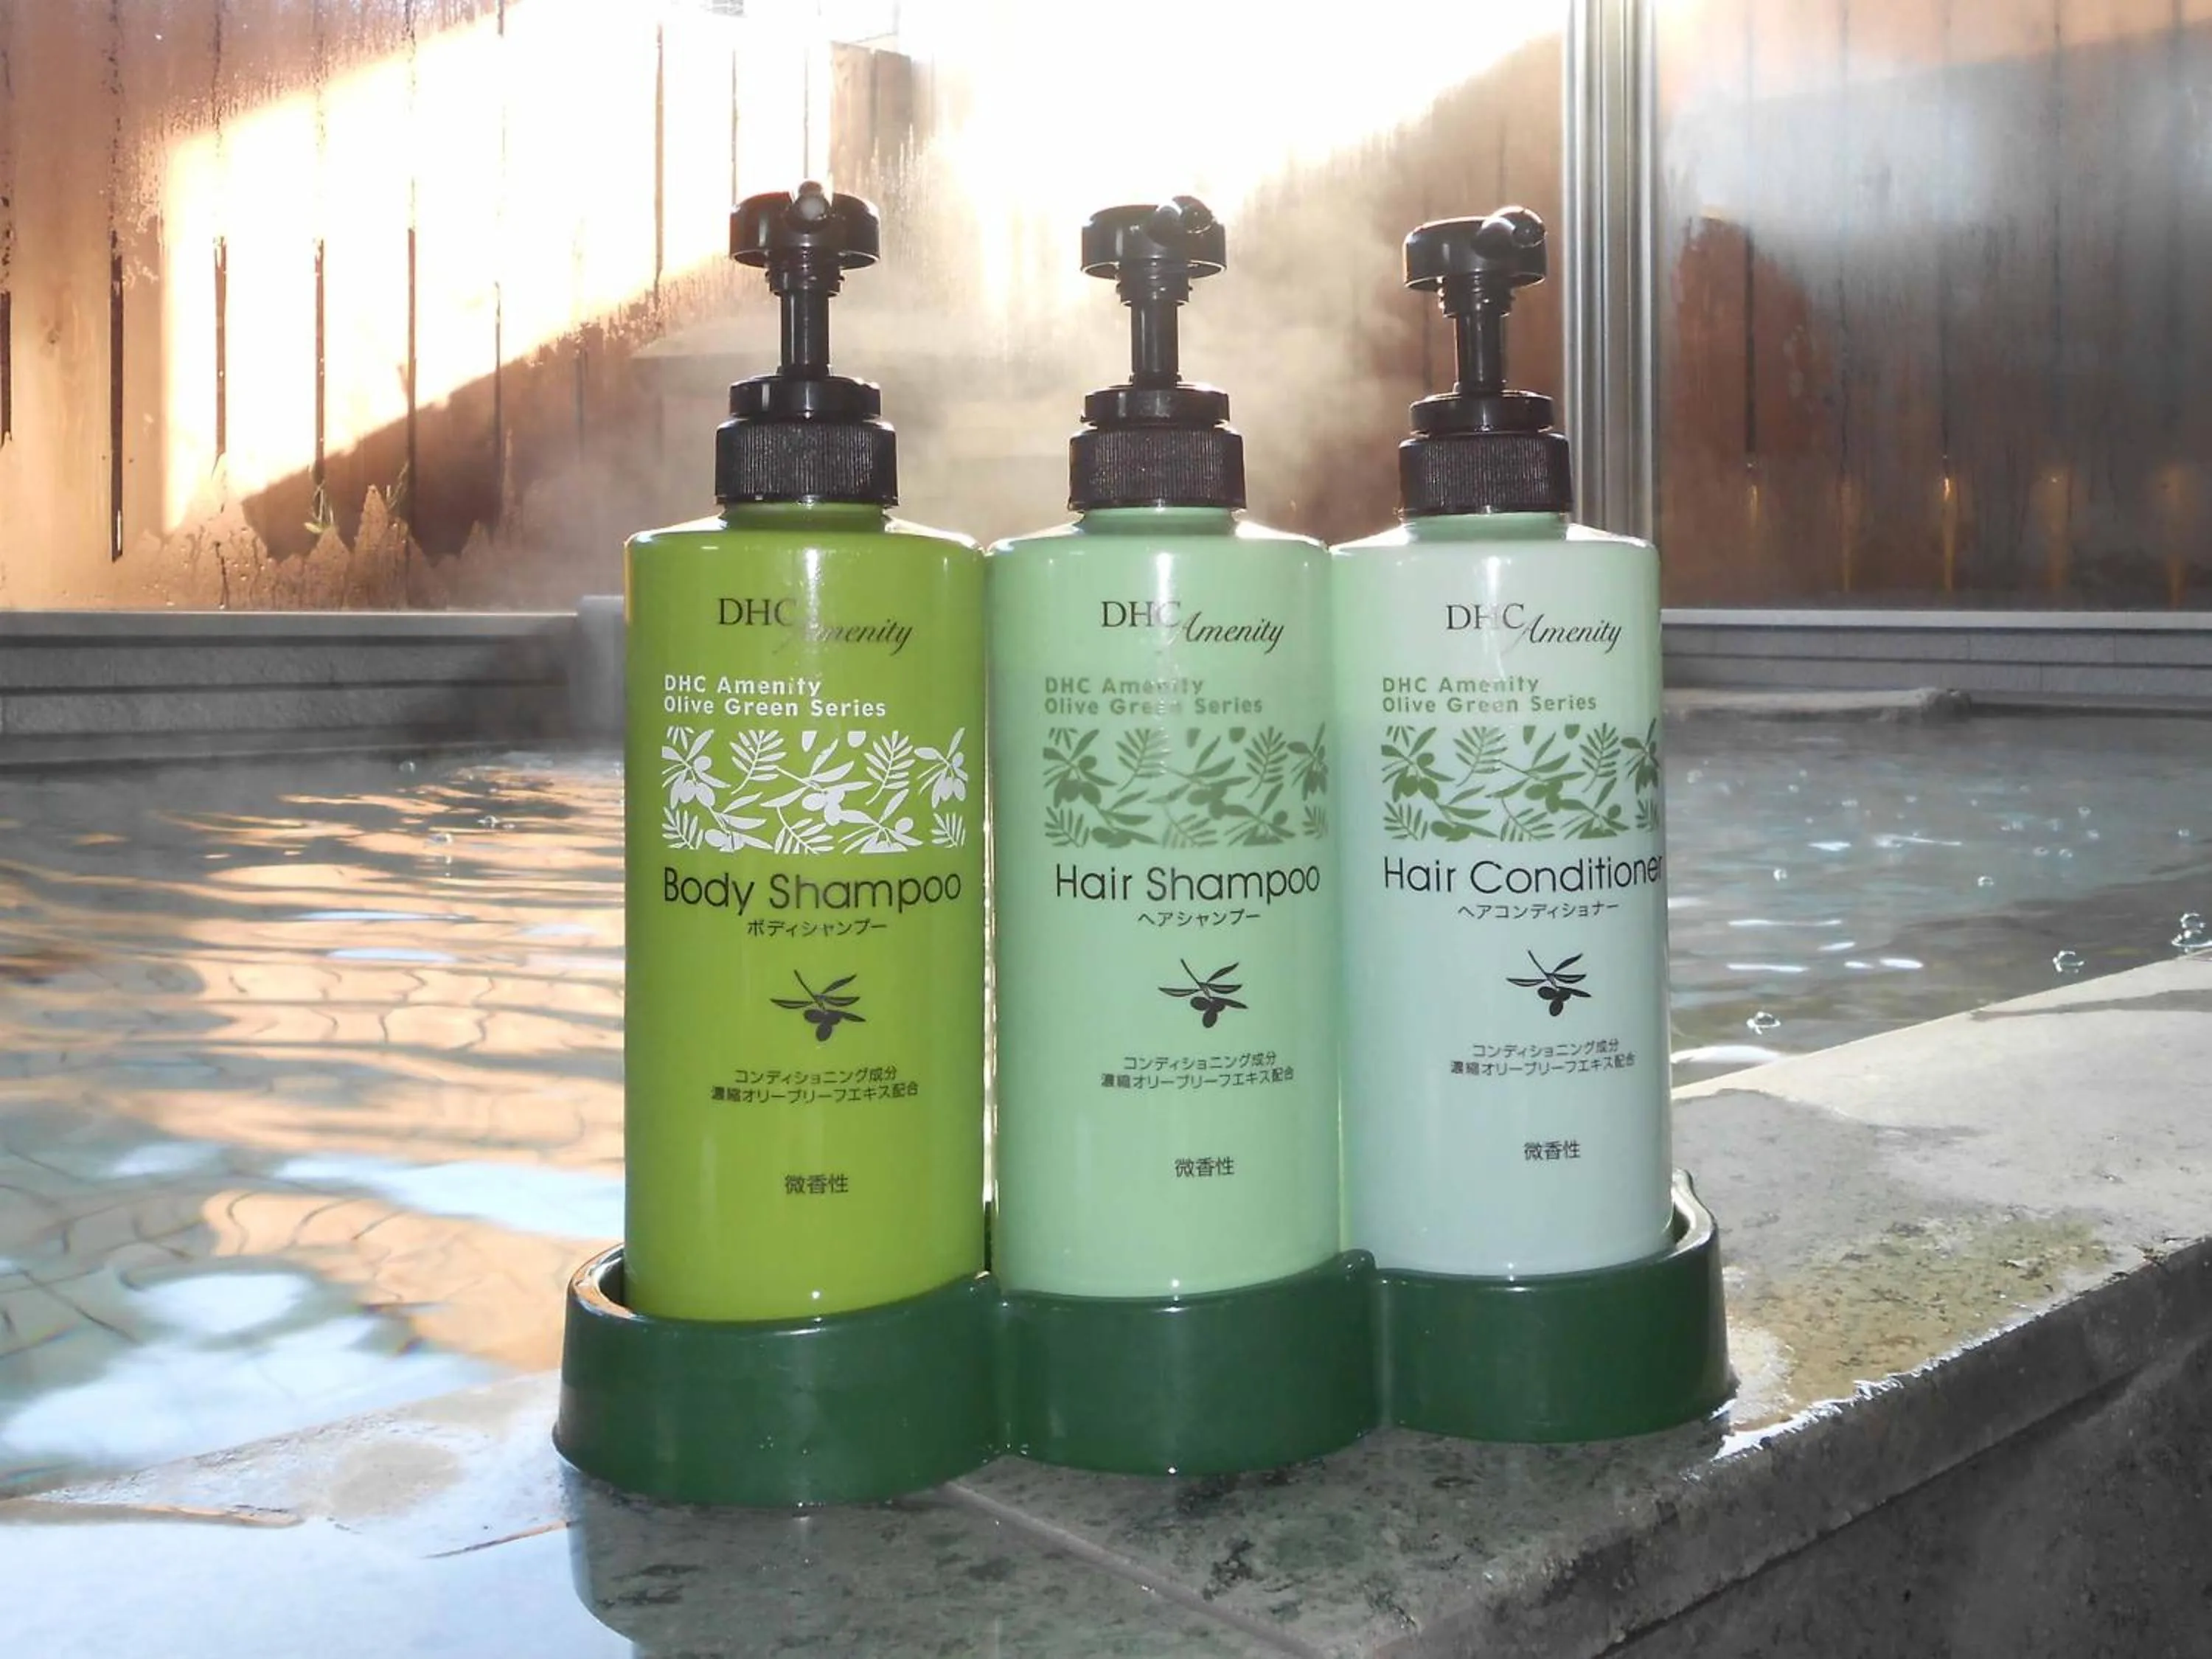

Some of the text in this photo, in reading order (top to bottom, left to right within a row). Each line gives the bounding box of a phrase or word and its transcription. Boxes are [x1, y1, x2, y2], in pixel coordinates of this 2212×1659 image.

[718, 597, 913, 655] DHC menity
[1101, 600, 1284, 654] DHC Amenity
[1446, 603, 1622, 654] DHC Amenity
[664, 675, 821, 695] DHC Amenity
[1045, 677, 1091, 694] DHC
[1382, 676, 1539, 693] DHC Amenity
[664, 696, 886, 717] Olive Green Series
[1045, 697, 1263, 715] Olive Gren Series
[1383, 695, 1596, 712] Olive Green Series
[1056, 863, 1320, 905] Hair Shampoo
[1383, 855, 1663, 894] Hair Conditioner
[664, 867, 961, 916] Body Shampoo
[1138, 908, 1261, 927] ヘアシャンプー
[1458, 901, 1619, 919] ヘアコンディショナー
[747, 918, 887, 937] ボディシャンプー
[1472, 1038, 1620, 1058] コンディショニング成分
[1124, 1051, 1277, 1071] コンディショニング成分
[734, 1065, 897, 1085] コンディショニング成分
[1523, 1139, 1581, 1161] 微香性
[1175, 1156, 1235, 1178] 微香性
[785, 1174, 849, 1194] 微香性
